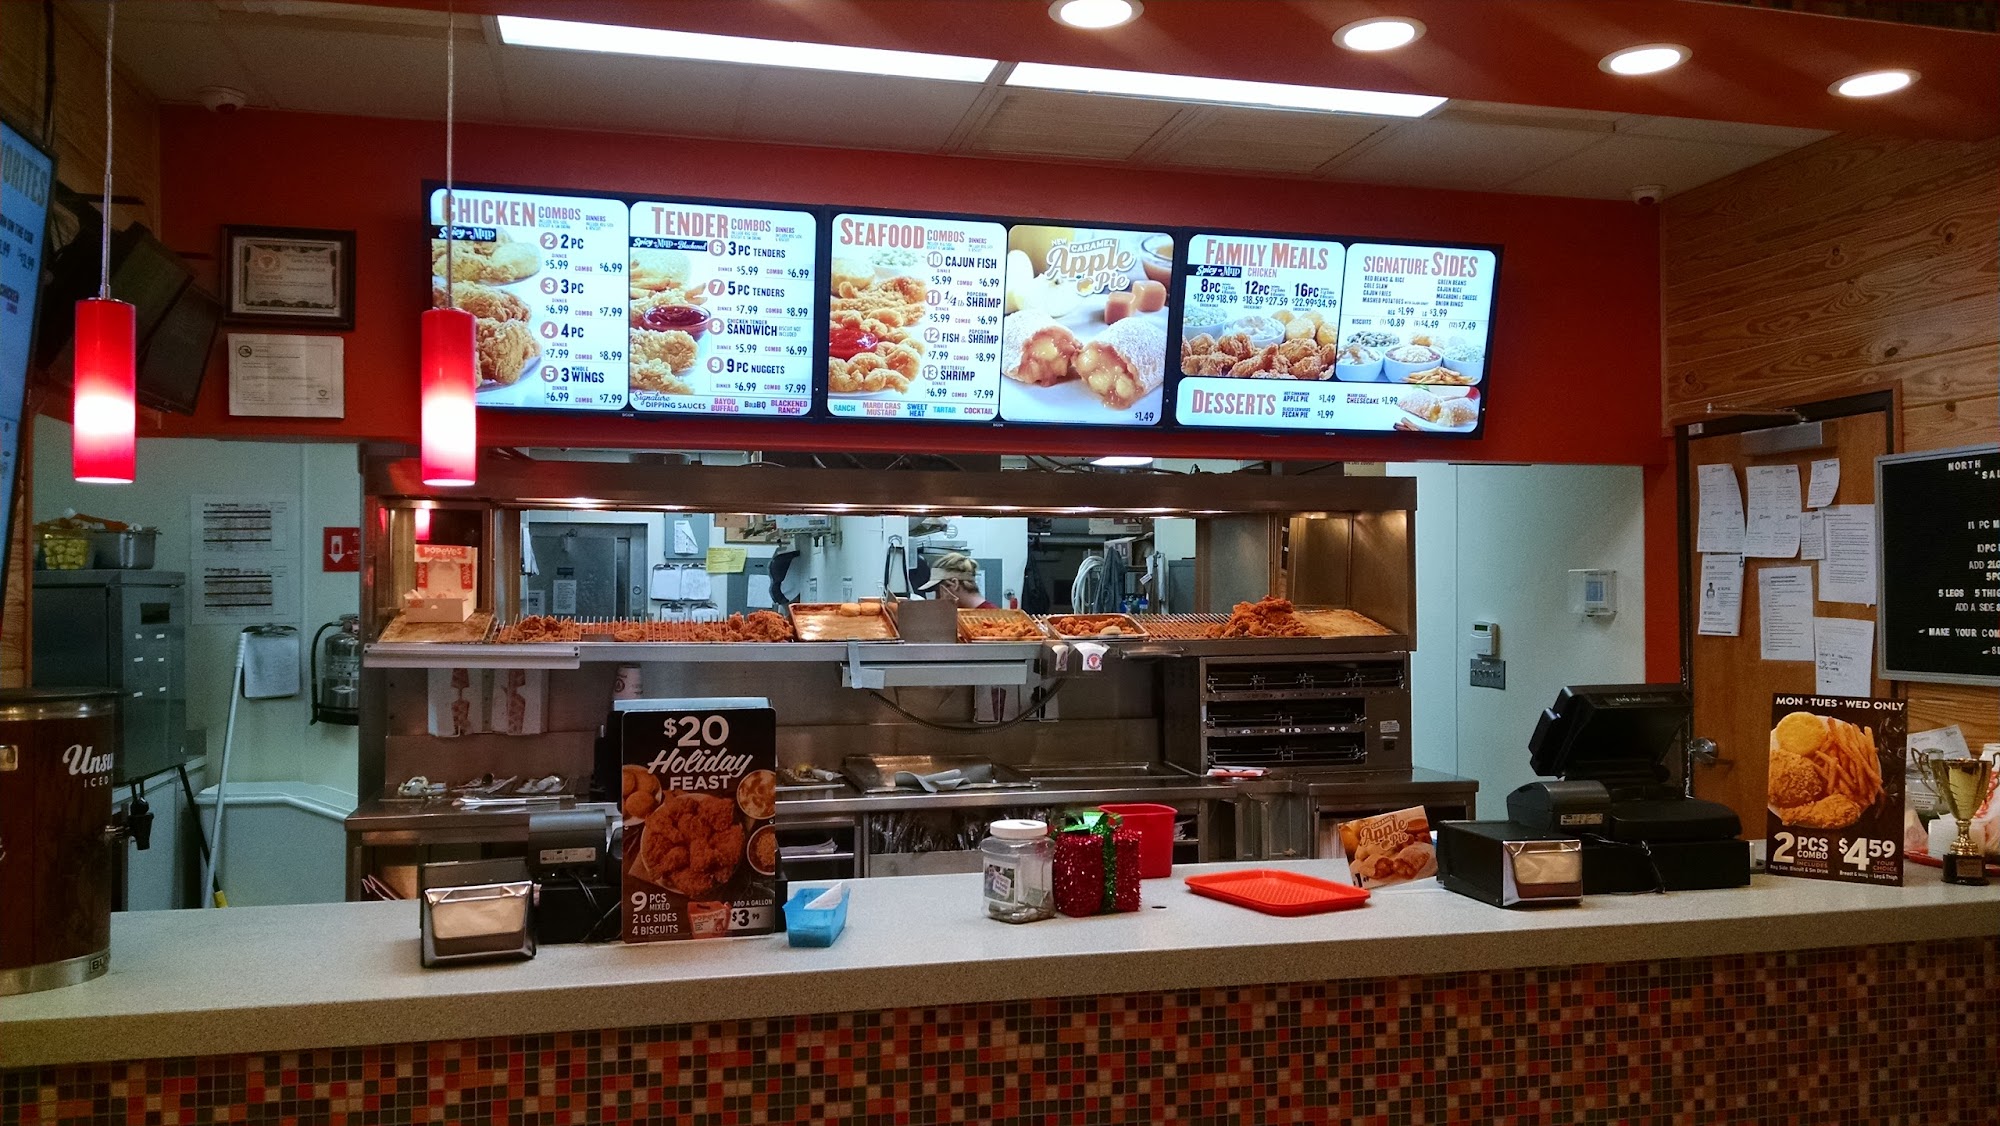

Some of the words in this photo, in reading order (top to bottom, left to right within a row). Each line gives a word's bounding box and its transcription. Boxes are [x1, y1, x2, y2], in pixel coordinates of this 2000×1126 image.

[442, 194, 535, 227] CHICKEN
[538, 206, 581, 220] COMBOS
[651, 207, 728, 238] TENDER
[731, 218, 771, 232] COMBOS
[840, 218, 924, 249] SEAFOOD
[927, 230, 964, 242] COMBOS
[1072, 239, 1115, 253] CARAMEL
[753, 248, 785, 258] TENDERS
[1205, 239, 1267, 267] FAMILY
[1271, 243, 1329, 270] MEALS
[545, 260, 568, 269] $5.99
[945, 256, 975, 268] CAJUN
[977, 258, 997, 269] FISH
[1046, 247, 1133, 279] Apple
[1363, 256, 1429, 275] SIGNATURE
[1431, 251, 1478, 278] SIDES
[600, 263, 623, 272] $6.99
[737, 266, 758, 276] $5.99
[787, 269, 809, 278] $6.99
[1247, 267, 1277, 278] CHICKEN
[931, 276, 952, 285] $5.99
[979, 278, 999, 287] $6.99
[1094, 271, 1129, 290] Pie
[752, 288, 784, 297] TENDERS
[966, 297, 1001, 308] SHRIMP
[1193, 293, 1215, 303] $12.99
[1216, 294, 1238, 303] $18.99
[1242, 296, 1264, 305] $18.59
[1265, 297, 1288, 306] $27.59
[1292, 299, 1314, 307] $22.99
[1314, 299, 1337, 308] $34.99
[546, 305, 569, 315] $6.99
[600, 308, 622, 317] $7.99
[736, 305, 757, 314] $7.99
[787, 308, 808, 317] $8.99
[1398, 307, 1414, 316] $1.99
[1430, 309, 1447, 317] $3.99
[930, 313, 950, 323] $5.99
[977, 316, 998, 324] $6.99
[1387, 319, 1405, 327] $0.89
[1421, 320, 1439, 328] $4.49
[1458, 322, 1476, 330] $7.49
[727, 324, 777, 337] SANDWICH
[942, 333, 960, 343] FISH
[968, 334, 999, 345] SHRIMP
[736, 344, 757, 353] $5.99
[786, 346, 807, 355] $6.99
[546, 349, 569, 359] $7.99
[600, 351, 622, 360] $8.99
[928, 351, 948, 360] $7.99
[975, 353, 996, 362] $8.99
[751, 365, 784, 374] NUGGETS
[571, 371, 604, 383] WINGS
[940, 370, 975, 381] SHRIMP
[735, 382, 756, 391] $6.99
[785, 384, 806, 393] $7.99
[546, 393, 569, 402] $6.99
[926, 389, 947, 397] $6.99
[974, 390, 994, 399] $7.99
[600, 395, 622, 403] $7.99
[633, 392, 670, 405] Signature
[1191, 390, 1276, 415] DESSERTS
[1319, 394, 1335, 403] $1.49
[1346, 397, 1379, 405] CHEESECAKE
[1382, 397, 1398, 405] $1.99
[646, 401, 676, 409] DIPPING
[771, 399, 807, 408] BLACKENED
[833, 404, 855, 412] RANCH
[884, 402, 901, 410] GRAS
[778, 406, 800, 414] RANCH
[866, 408, 897, 416] MUSTARD
[933, 405, 956, 414] TARTAR
[964, 407, 993, 415] COCKTAIL
[1135, 412, 1154, 421] $1.49
[1317, 410, 1334, 419] $1.99
[1948, 460, 1981, 471] NORTH
[1969, 561, 1985, 569] ADD
[1945, 589, 1964, 597] LEGS
[1955, 603, 1969, 611] ADD
[1970, 603, 1976, 611] A
[1979, 603, 1995, 611] SIDE
[1929, 628, 1950, 636] MAKE
[1955, 628, 1977, 637] YOUR
[1776, 697, 1801, 706] MON
[1810, 698, 1837, 708] TUES
[1845, 700, 1871, 709] WED
[1873, 702, 1904, 711] ONLY
[664, 715, 729, 747] $20
[647, 747, 753, 778] Holiday
[670, 775, 731, 791] FEAST
[1361, 819, 1407, 845] Apple
[1390, 832, 1407, 846] Pie
[1773, 832, 1795, 864] 2
[1797, 836, 1828, 852] PCS
[1797, 850, 1828, 860] COMBO
[631, 891, 647, 912] 9
[649, 893, 667, 903] PCS
[649, 903, 670, 911] MIXED
[632, 915, 639, 923] 2
[641, 915, 651, 923] LG
[653, 913, 677, 922] SIDES
[632, 927, 639, 935] 4
[641, 925, 678, 935] BISCUITS
